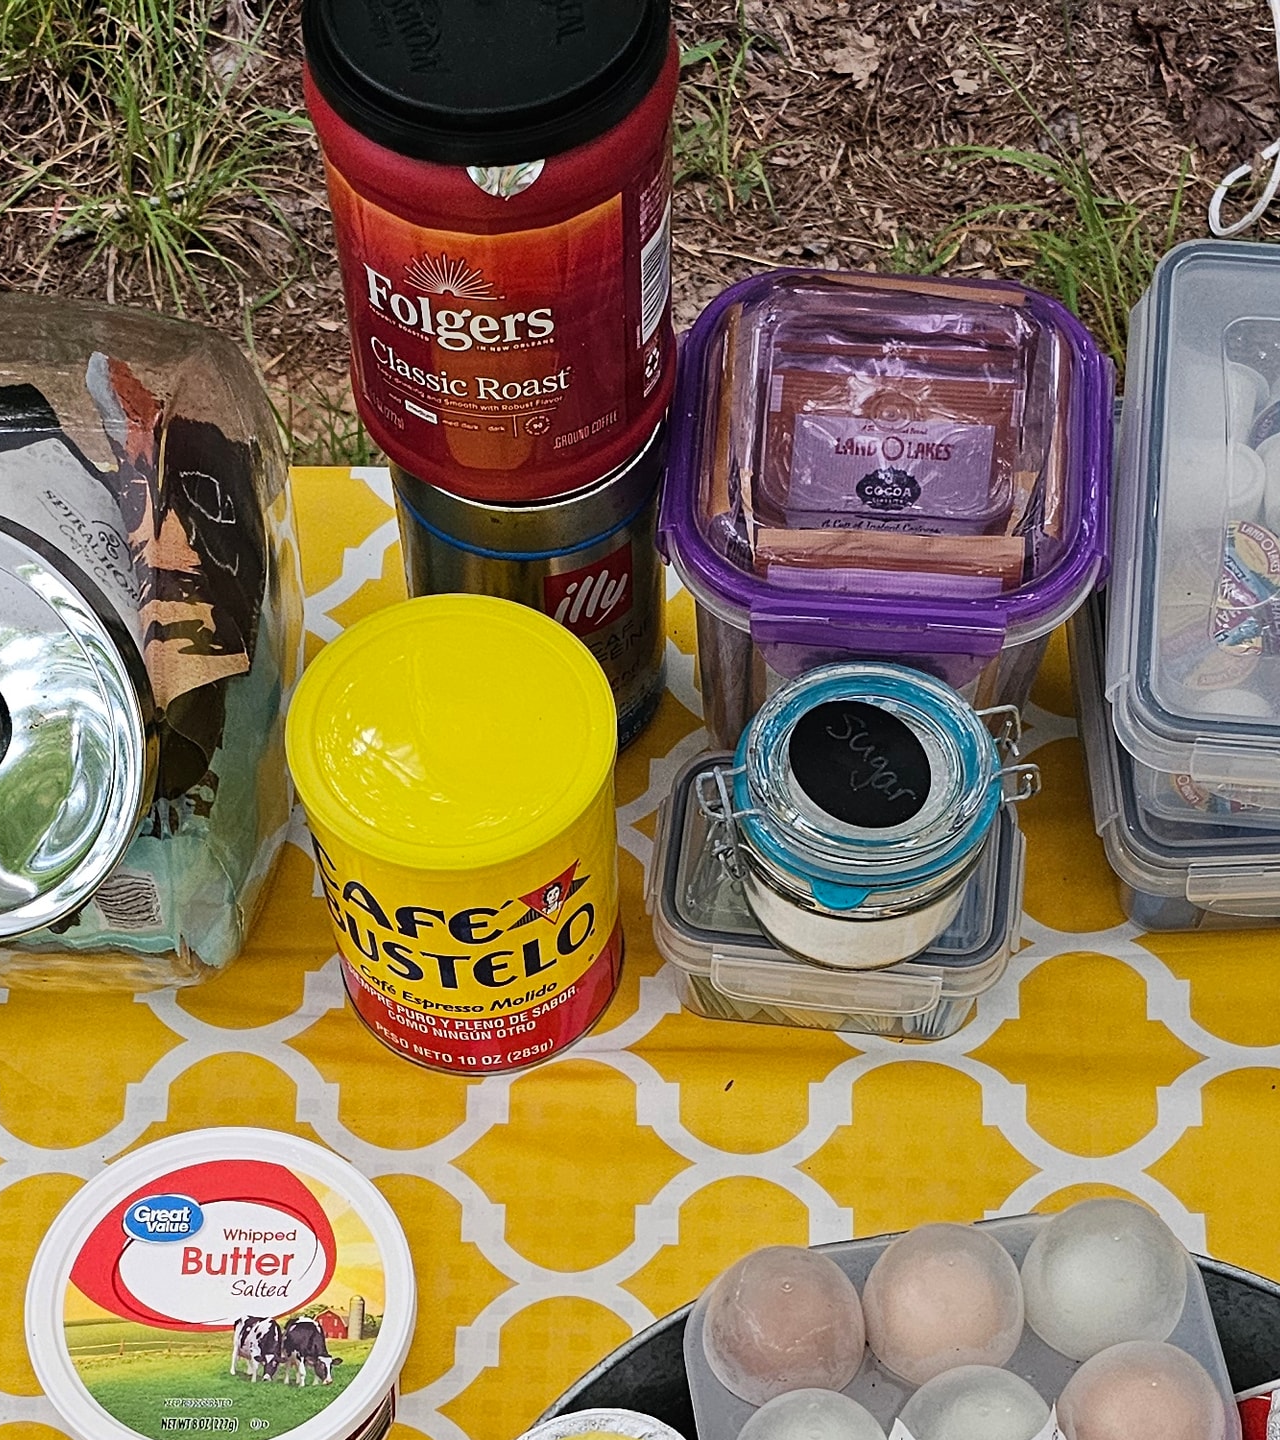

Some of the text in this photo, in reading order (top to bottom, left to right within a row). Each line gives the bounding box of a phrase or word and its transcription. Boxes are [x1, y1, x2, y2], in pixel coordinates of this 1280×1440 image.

[363, 263, 555, 351] Folgers
[371, 337, 468, 397] Classic
[475, 369, 569, 401] Roast
[554, 425, 590, 450] GROUND
[591, 410, 618, 435] COFFEE
[907, 441, 951, 461] LAKES
[864, 485, 912, 498] COCOA
[554, 570, 628, 625] illy
[825, 713, 918, 802] Sugar
[358, 963, 558, 1013] Café Espresso Molido
[387, 1009, 537, 1041] COMO NINGÚN OTRO
[396, 1004, 436, 1027] PURO
[442, 1018, 450, 1029] Y
[454, 1017, 505, 1032] PLENO
[509, 1011, 529, 1026] DE
[531, 986, 577, 1018] SABOR
[375, 1020, 555, 1067] PESO NETO 10 OZ (283g)
[134, 1205, 193, 1223] Great
[146, 1219, 190, 1233] Value
[223, 1227, 297, 1243] Whipped
[181, 1246, 295, 1276] Butter
[231, 1278, 290, 1298] Salted
[161, 1417, 239, 1432] NET WT (227g)
